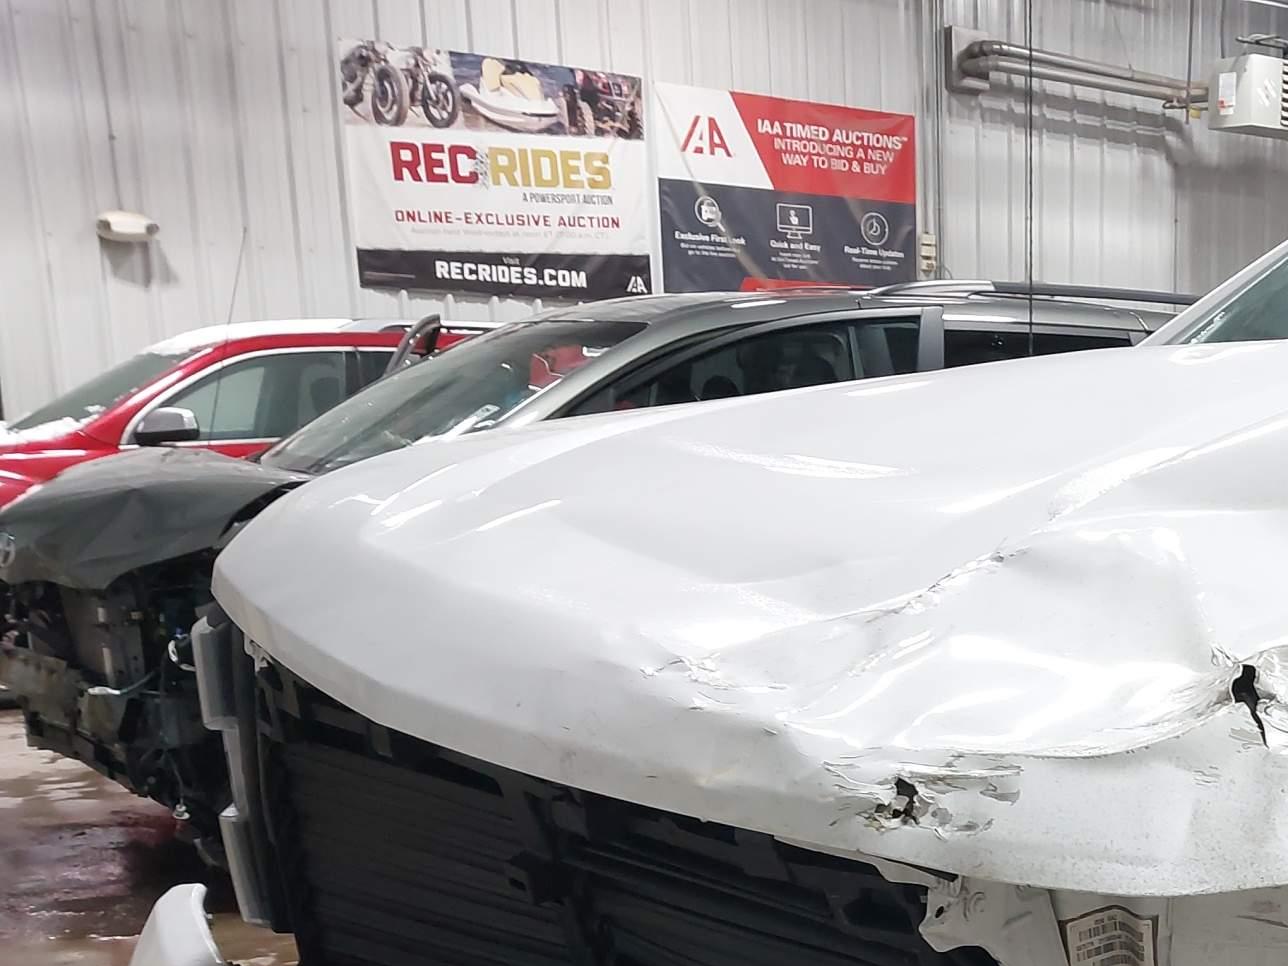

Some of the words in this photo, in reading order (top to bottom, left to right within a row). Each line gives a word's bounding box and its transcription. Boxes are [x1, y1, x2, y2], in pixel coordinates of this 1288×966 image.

[757, 118, 782, 136] IAA
[784, 121, 829, 141] TIMED
[774, 137, 853, 158] INTRODUCING
[856, 148, 865, 158] A
[867, 149, 894, 163] NEW
[487, 146, 612, 190] RIDES
[781, 152, 809, 167] WAY
[812, 155, 828, 169] TO
[830, 158, 850, 172] BID
[851, 160, 861, 173] &
[863, 161, 888, 175] BUY
[522, 192, 528, 202] A
[529, 192, 581, 205] POWERSPORT
[582, 194, 613, 206] AUCTION
[395, 209, 551, 228] ONLINE-EXCLUSIVE
[557, 215, 621, 229] AUCTION
[770, 240, 789, 249] Quick
[790, 241, 802, 250] and
[804, 243, 821, 253] Easy
[502, 256, 520, 265] Visit
[435, 260, 587, 288] RECRIDES.COM
